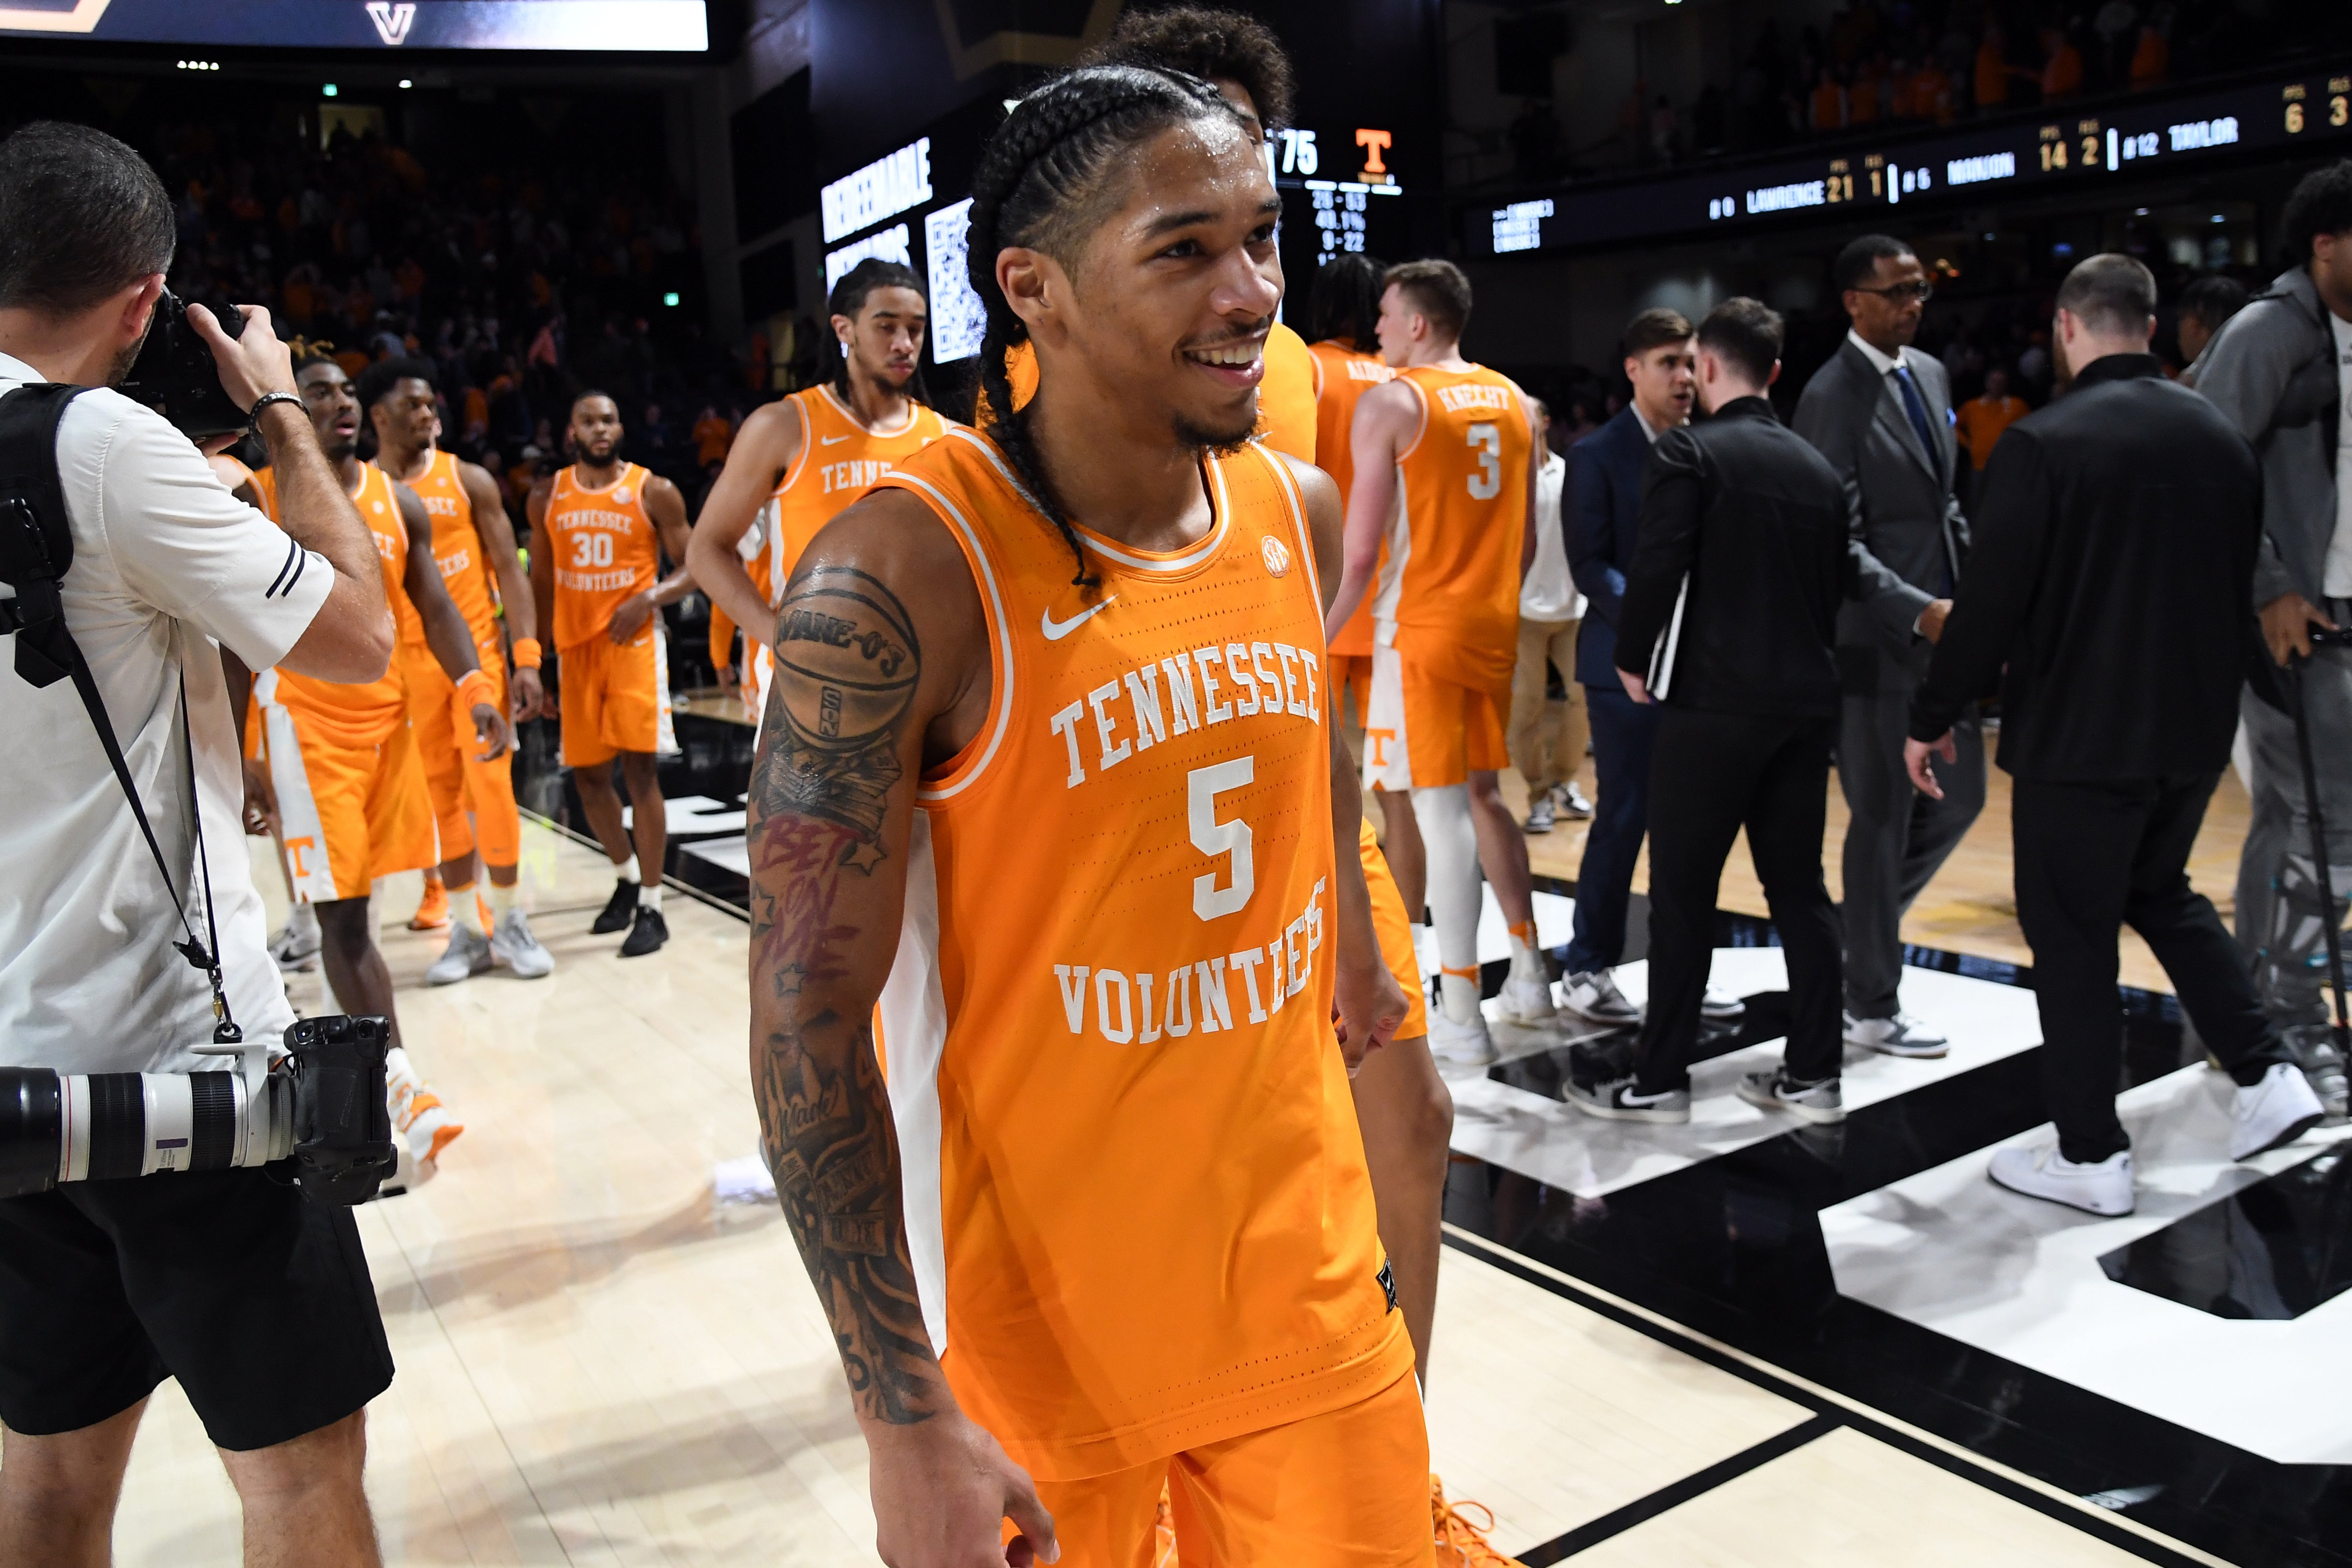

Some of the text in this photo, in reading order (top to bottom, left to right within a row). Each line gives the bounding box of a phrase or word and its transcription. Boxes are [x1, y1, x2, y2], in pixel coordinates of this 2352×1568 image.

[2168, 116, 2239, 151] TAYLOR
[2285, 103, 2305, 133] 6
[2330, 96, 2350, 126] 3
[1278, 128, 1318, 175] 75
[2040, 140, 2068, 171] 14
[2082, 136, 2099, 165] 2
[1747, 180, 1826, 214] LAWRENCE
[1827, 174, 1854, 203] 21
[1870, 169, 1881, 197] 1
[1436, 384, 1510, 413] KNECHT
[1466, 424, 1502, 500] 3
[557, 509, 633, 535] TENNESSEE
[572, 532, 613, 567] 30
[557, 566, 635, 592] VOLUNTEERS
[1051, 642, 1319, 789] TENNESSEE
[1367, 728, 1396, 766] T
[1187, 755, 1254, 922] 5
